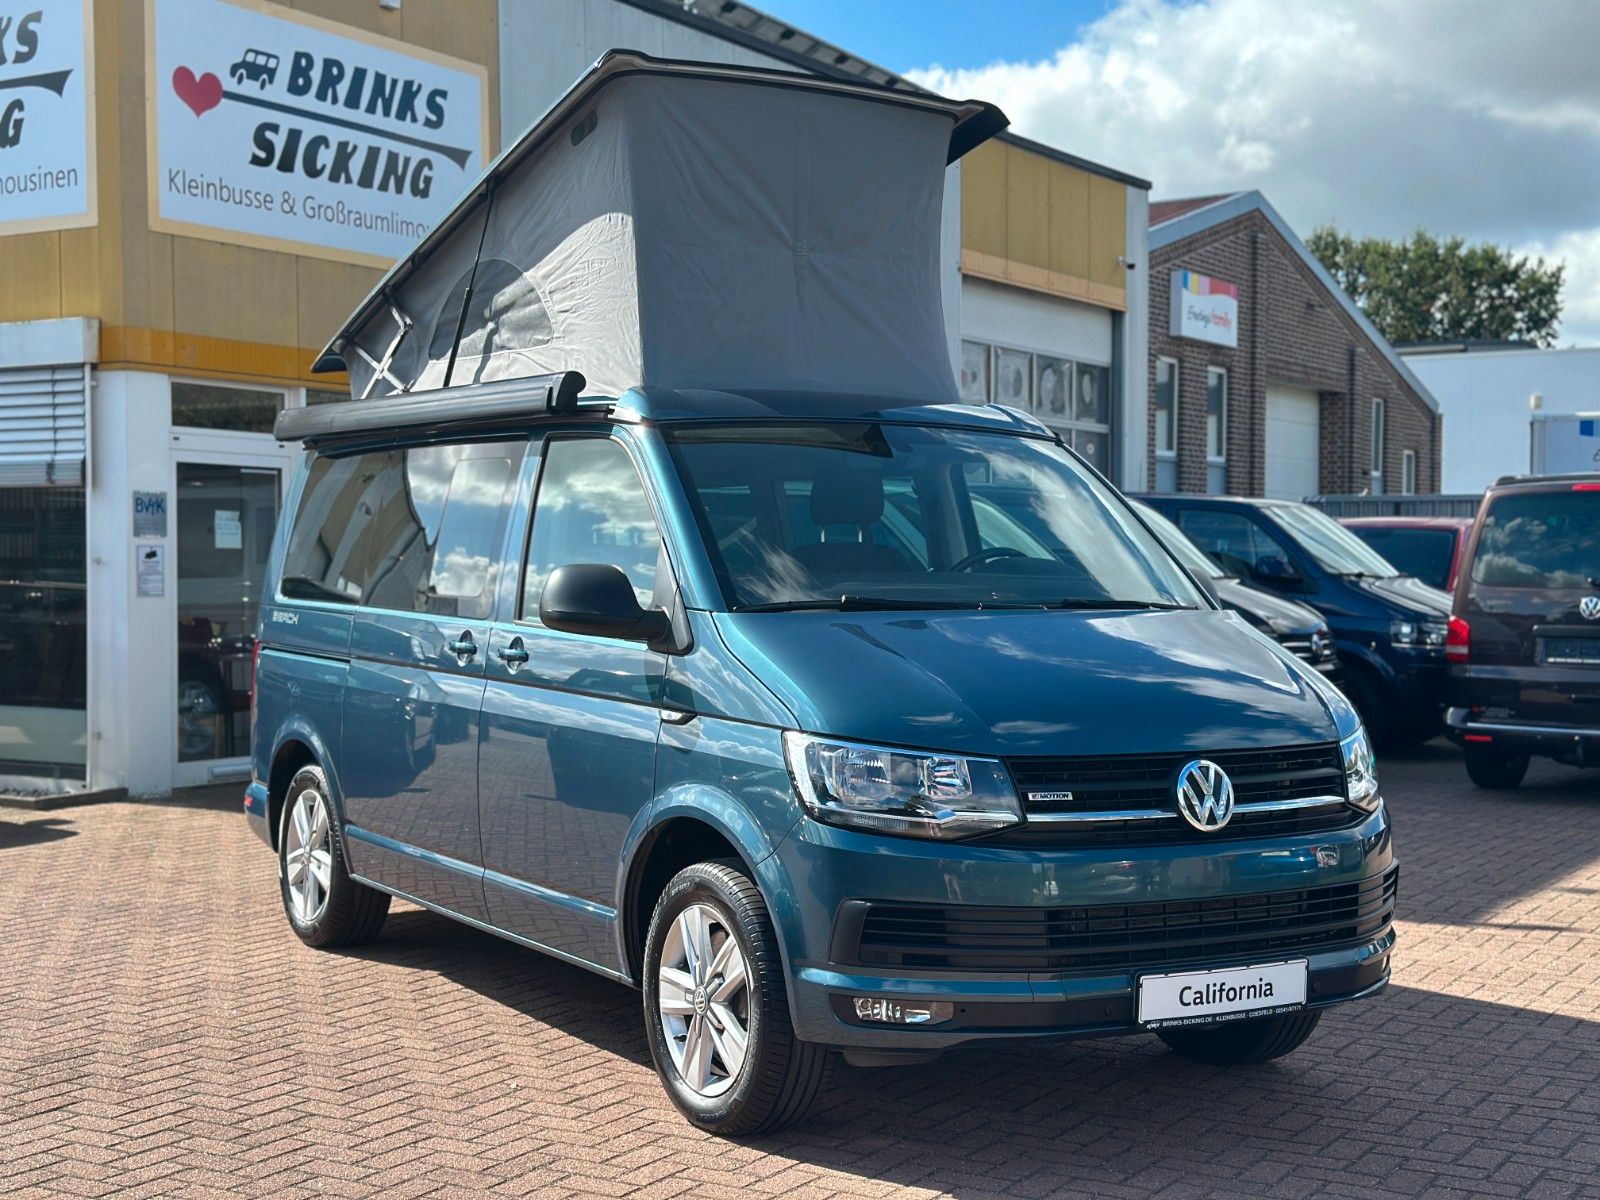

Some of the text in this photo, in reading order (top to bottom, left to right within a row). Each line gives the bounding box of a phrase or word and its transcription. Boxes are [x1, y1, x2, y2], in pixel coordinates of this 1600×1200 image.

[286, 50, 448, 130] BRINKS
[249, 121, 434, 199] SICKING
[168, 168, 430, 239] Kleinbusse & Großraumlimo
[1178, 977, 1274, 1007] California
